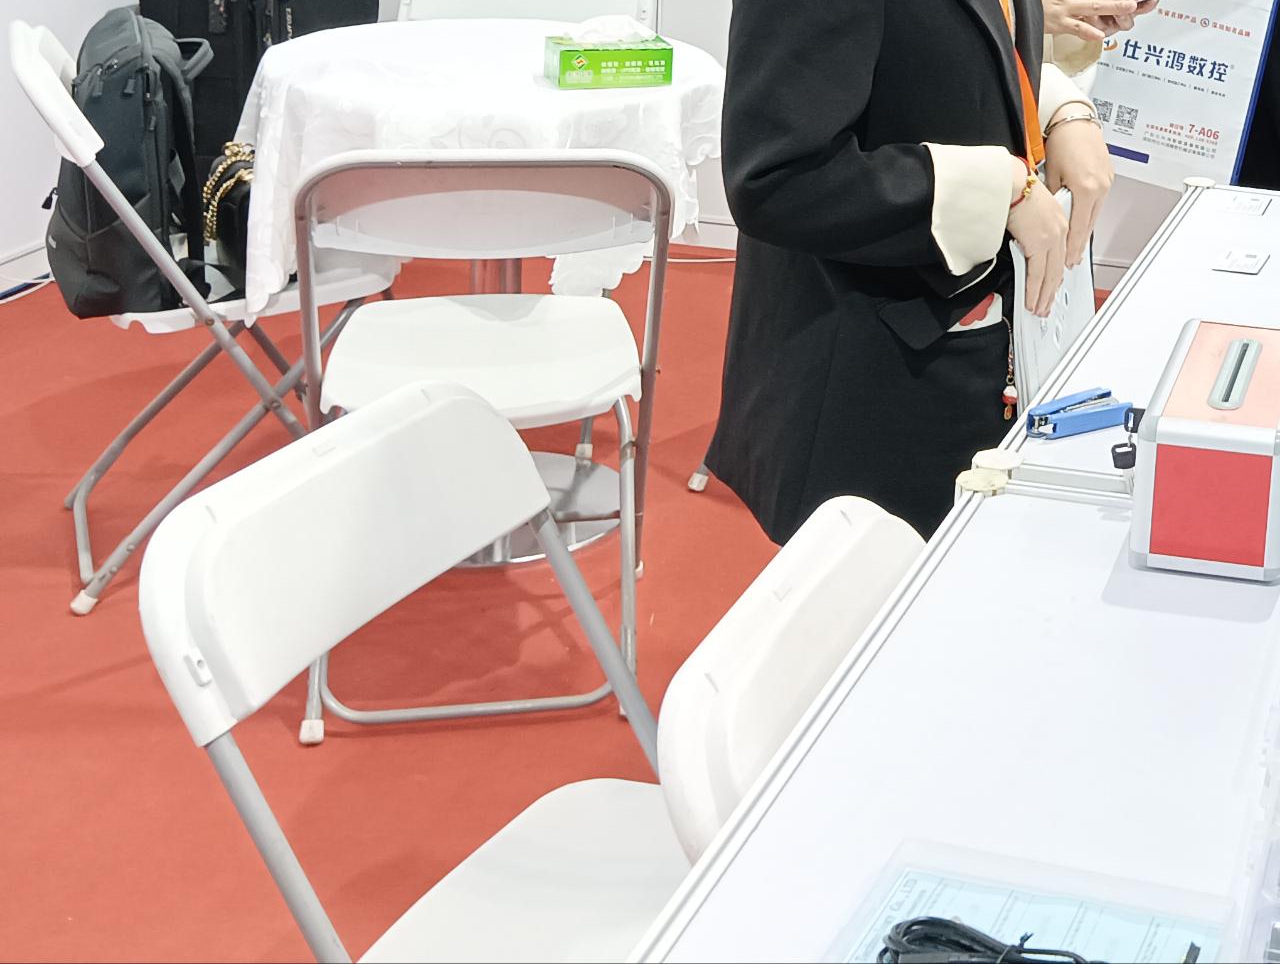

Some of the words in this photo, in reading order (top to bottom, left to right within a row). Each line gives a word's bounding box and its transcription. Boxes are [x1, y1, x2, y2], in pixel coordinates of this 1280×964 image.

[1122, 38, 1230, 83] 仕兴鸿数控
[1188, 123, 1220, 140] 7-A06
